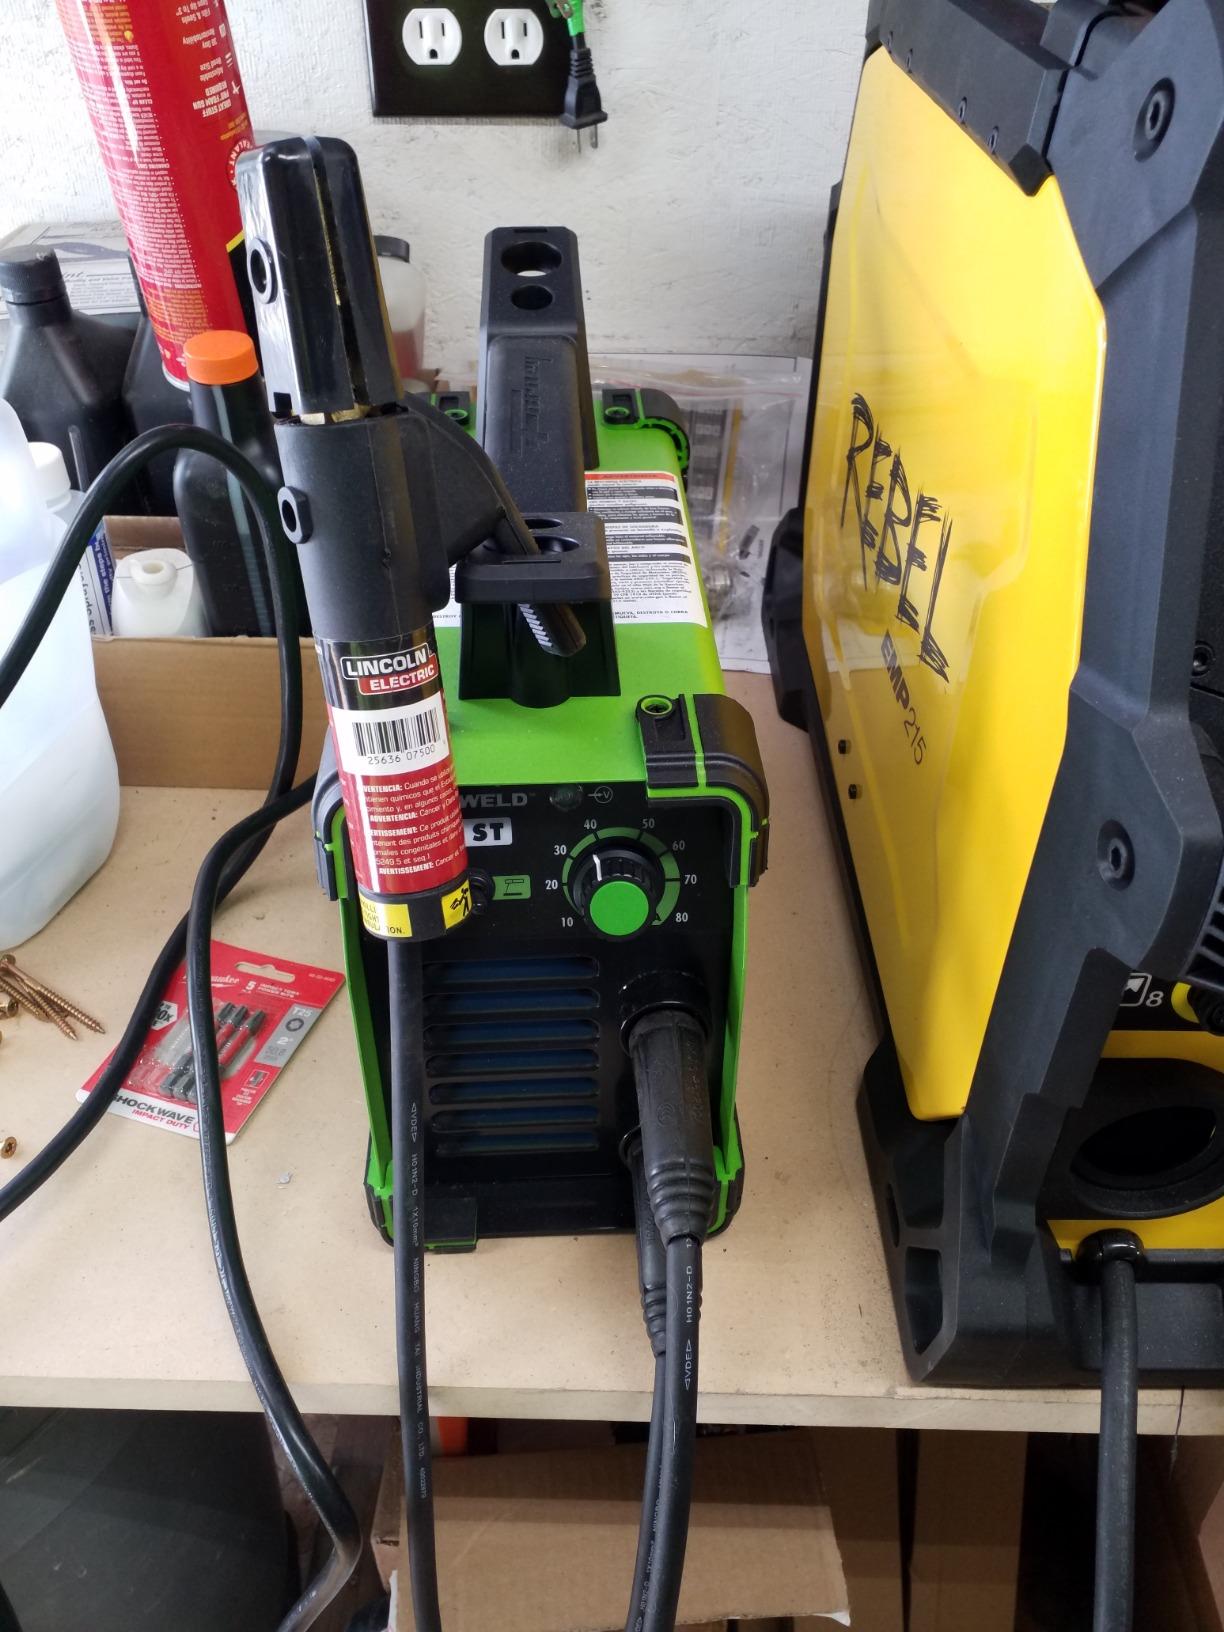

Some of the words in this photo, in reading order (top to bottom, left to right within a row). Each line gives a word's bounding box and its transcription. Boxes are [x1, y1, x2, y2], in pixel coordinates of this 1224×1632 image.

[840, 392, 953, 684] REBEL
[346, 648, 429, 677] LINCOLN
[369, 664, 435, 692] ELECTRIC
[902, 707, 927, 766] 215
[368, 754, 401, 766] 25636
[406, 744, 435, 761] 07500
[404, 779, 430, 790] Cuando
[415, 796, 439, 808] algunos
[459, 792, 528, 809] WELD
[370, 812, 418, 822] ADVERTENCIA:
[583, 819, 597, 830] 40
[642, 818, 655, 829] 50
[473, 822, 504, 842] ST
[398, 838, 412, 846] des
[672, 840, 685, 851] 60
[553, 844, 567, 856] 30
[379, 862, 435, 875] AVERTISSEMENT:
[545, 879, 559, 890] 20
[684, 874, 697, 885] 70
[560, 917, 574, 927] 10
[675, 912, 689, 923] 80
[246, 981, 257, 991] 5
[1145, 990, 1164, 1007] 8
[291, 1007, 313, 1017] T25
[112, 1094, 196, 1124] HOCKWAVE
[131, 1109, 165, 1122] IMPACT
[165, 1119, 190, 1130] DUTY
[685, 1265, 693, 1323] H01N2-D
